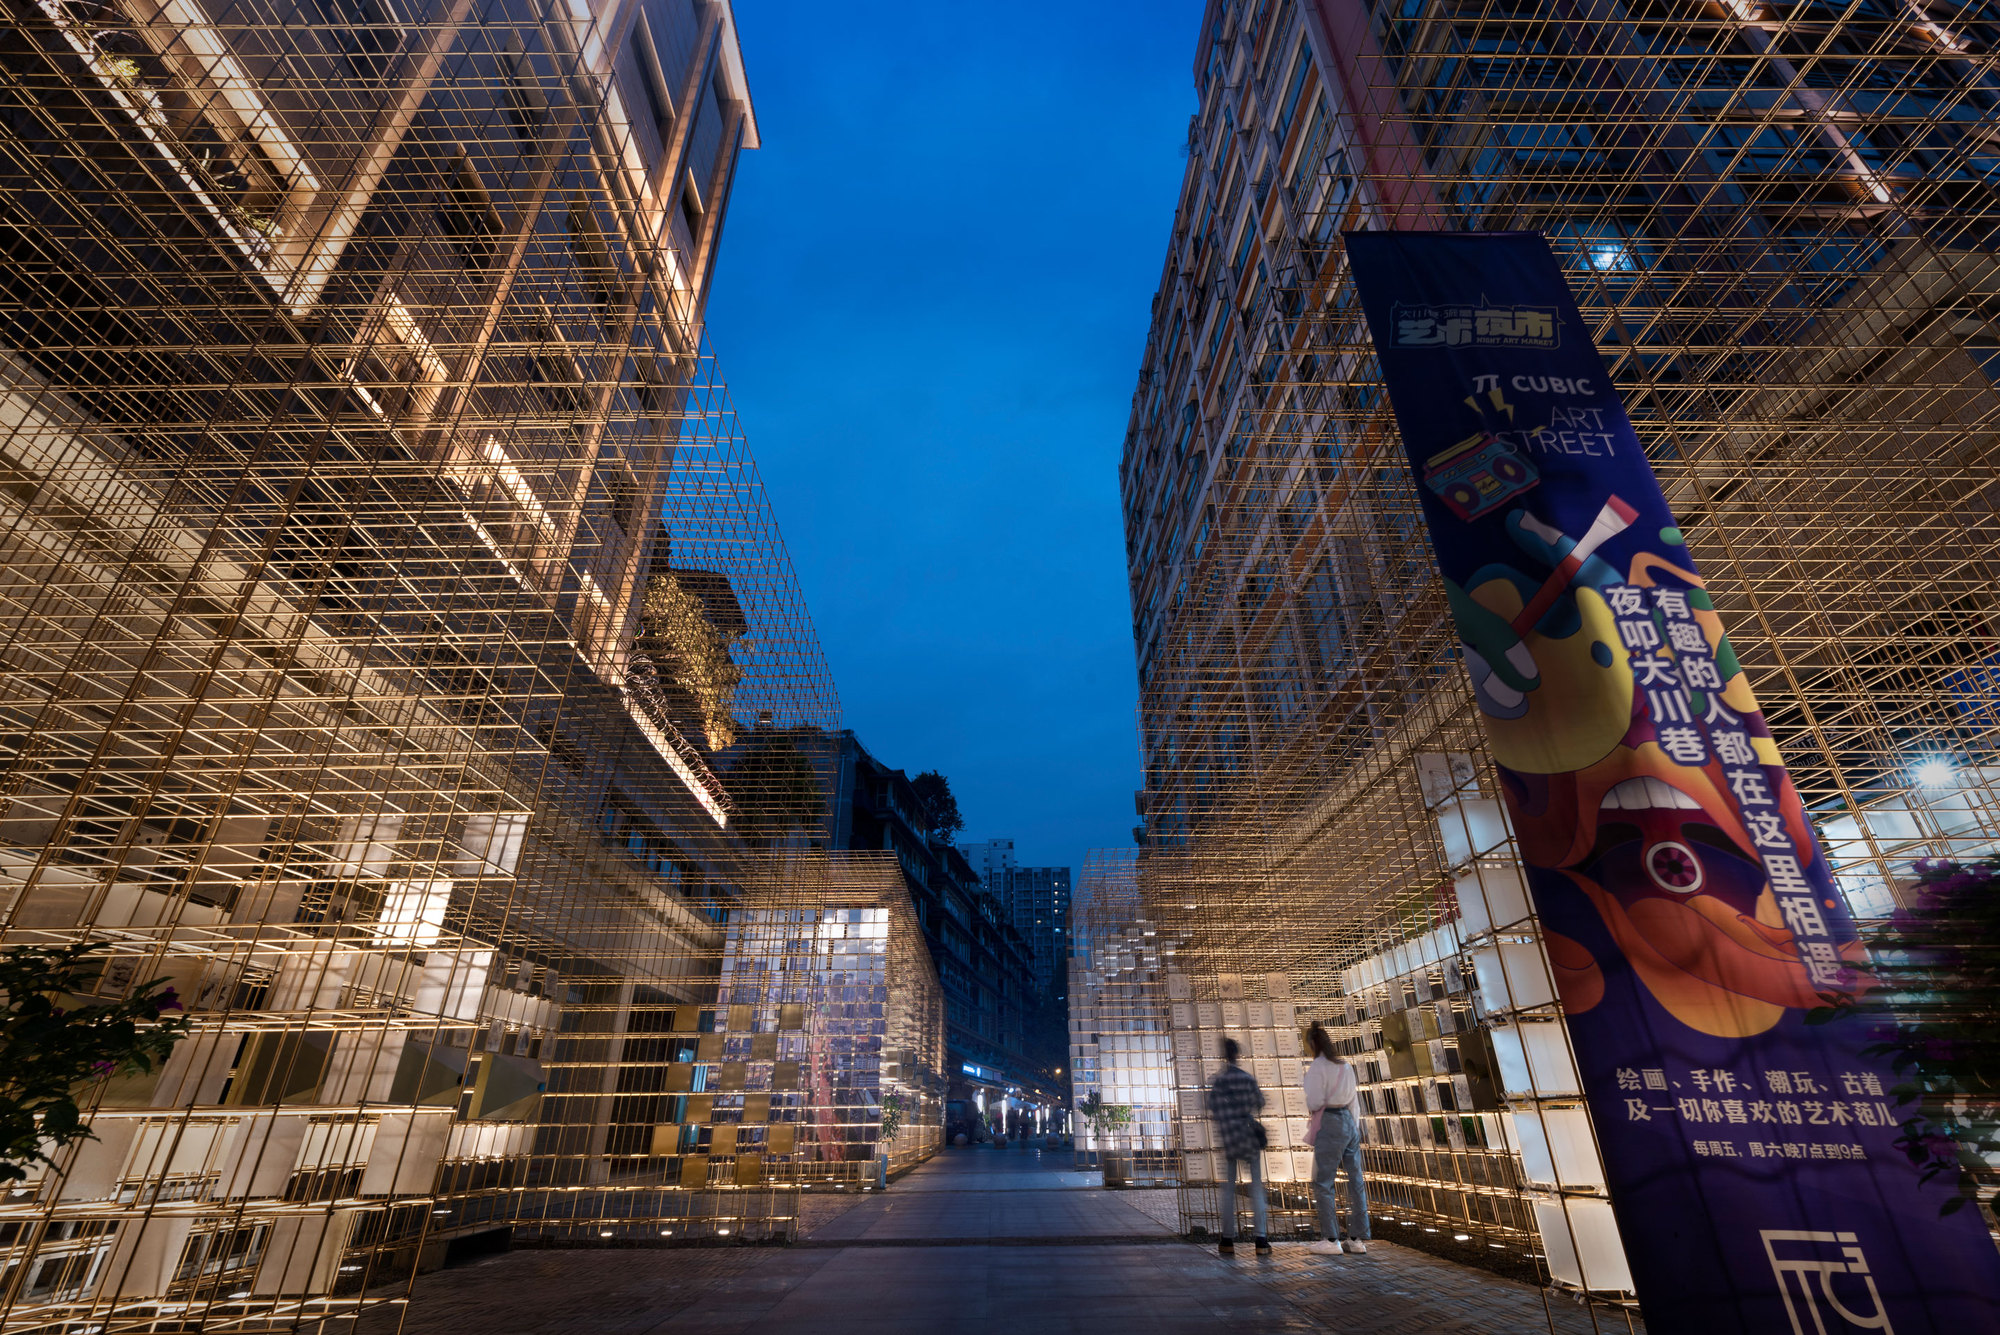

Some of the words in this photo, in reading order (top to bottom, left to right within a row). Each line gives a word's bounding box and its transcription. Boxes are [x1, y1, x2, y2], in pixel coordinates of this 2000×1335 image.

[1398, 309, 1553, 345] 艺术夜市
[1476, 336, 1501, 344] NIGHT
[1503, 337, 1519, 345] ART
[1521, 338, 1554, 347] MARKET
[1511, 374, 1596, 396] CUBIC
[1551, 405, 1604, 430] ART
[1495, 429, 1616, 457] STREET
[1605, 585, 1706, 763] 夜叩大川巷
[1652, 587, 1845, 987] 有趣的人都在这里相遇
[1624, 1098, 1899, 1127] 及一切你喜欢的艺术范儿
